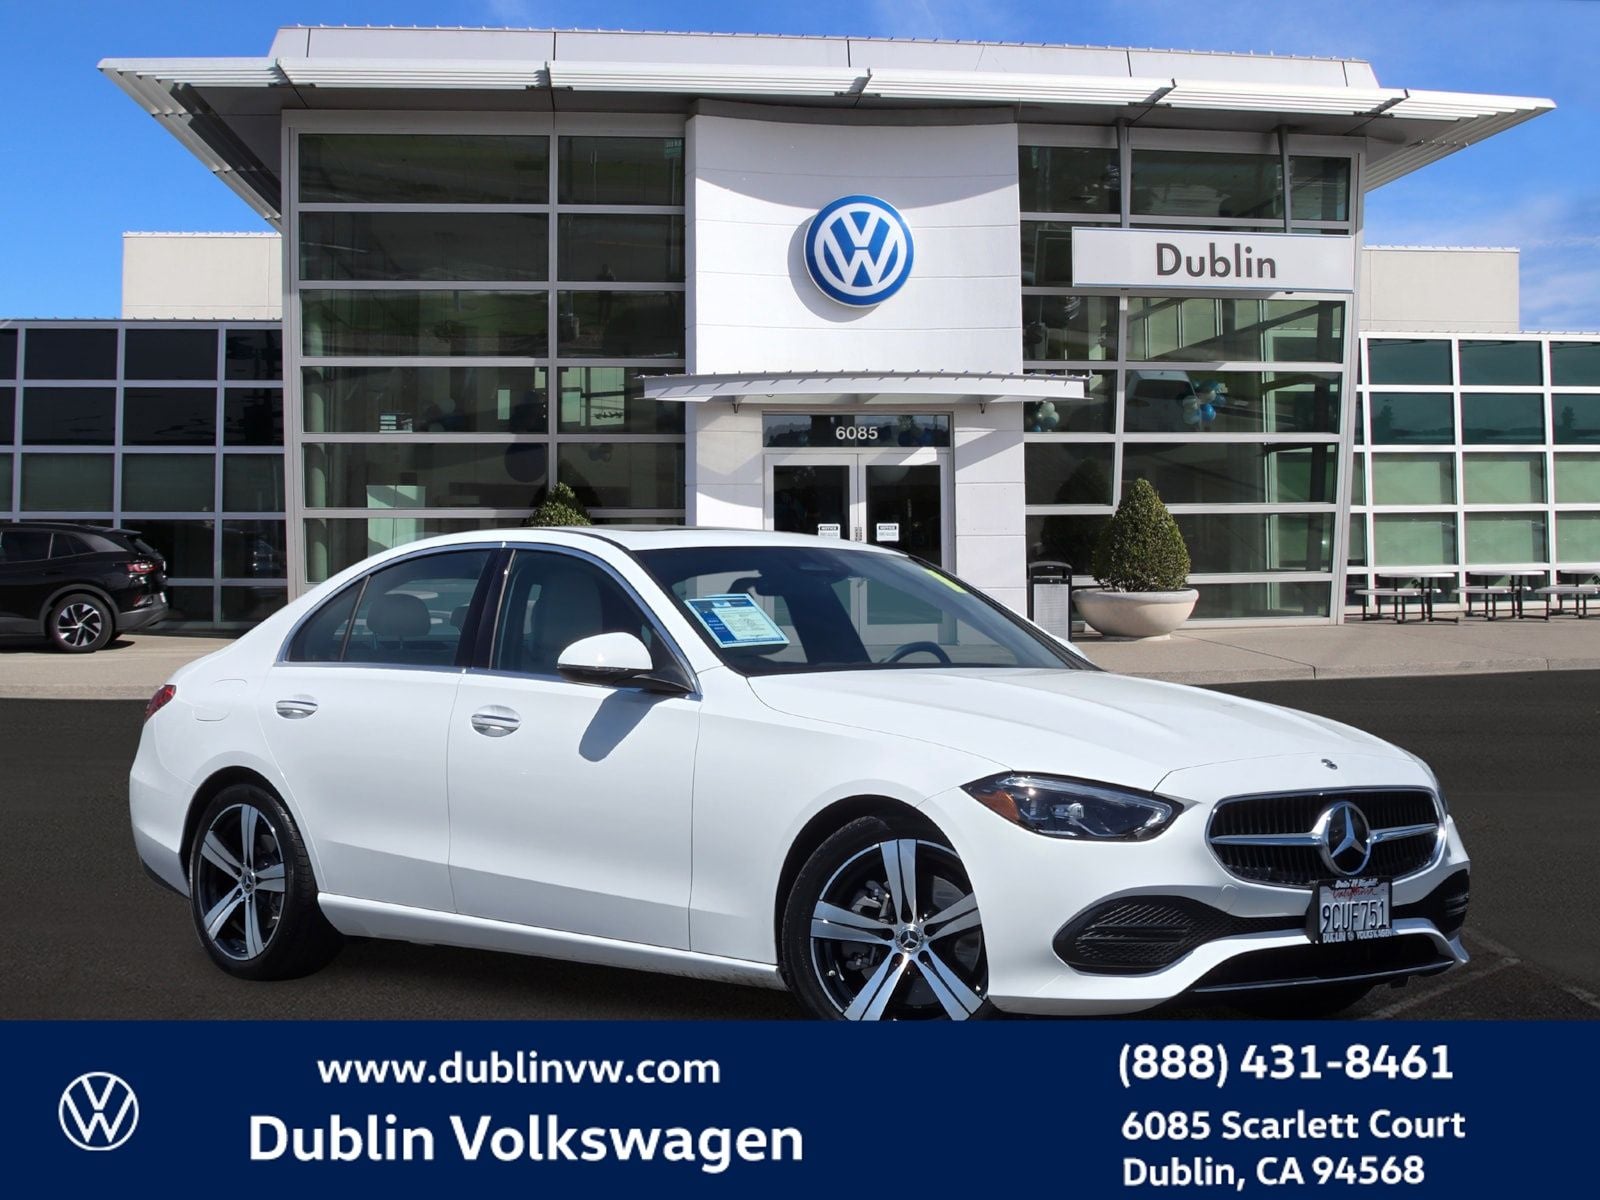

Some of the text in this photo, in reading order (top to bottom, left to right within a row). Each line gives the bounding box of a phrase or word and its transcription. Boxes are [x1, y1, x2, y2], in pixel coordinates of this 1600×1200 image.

[1156, 243, 1276, 278] Dublin
[835, 426, 878, 440] 6085
[1322, 900, 1387, 933] 9CUF751
